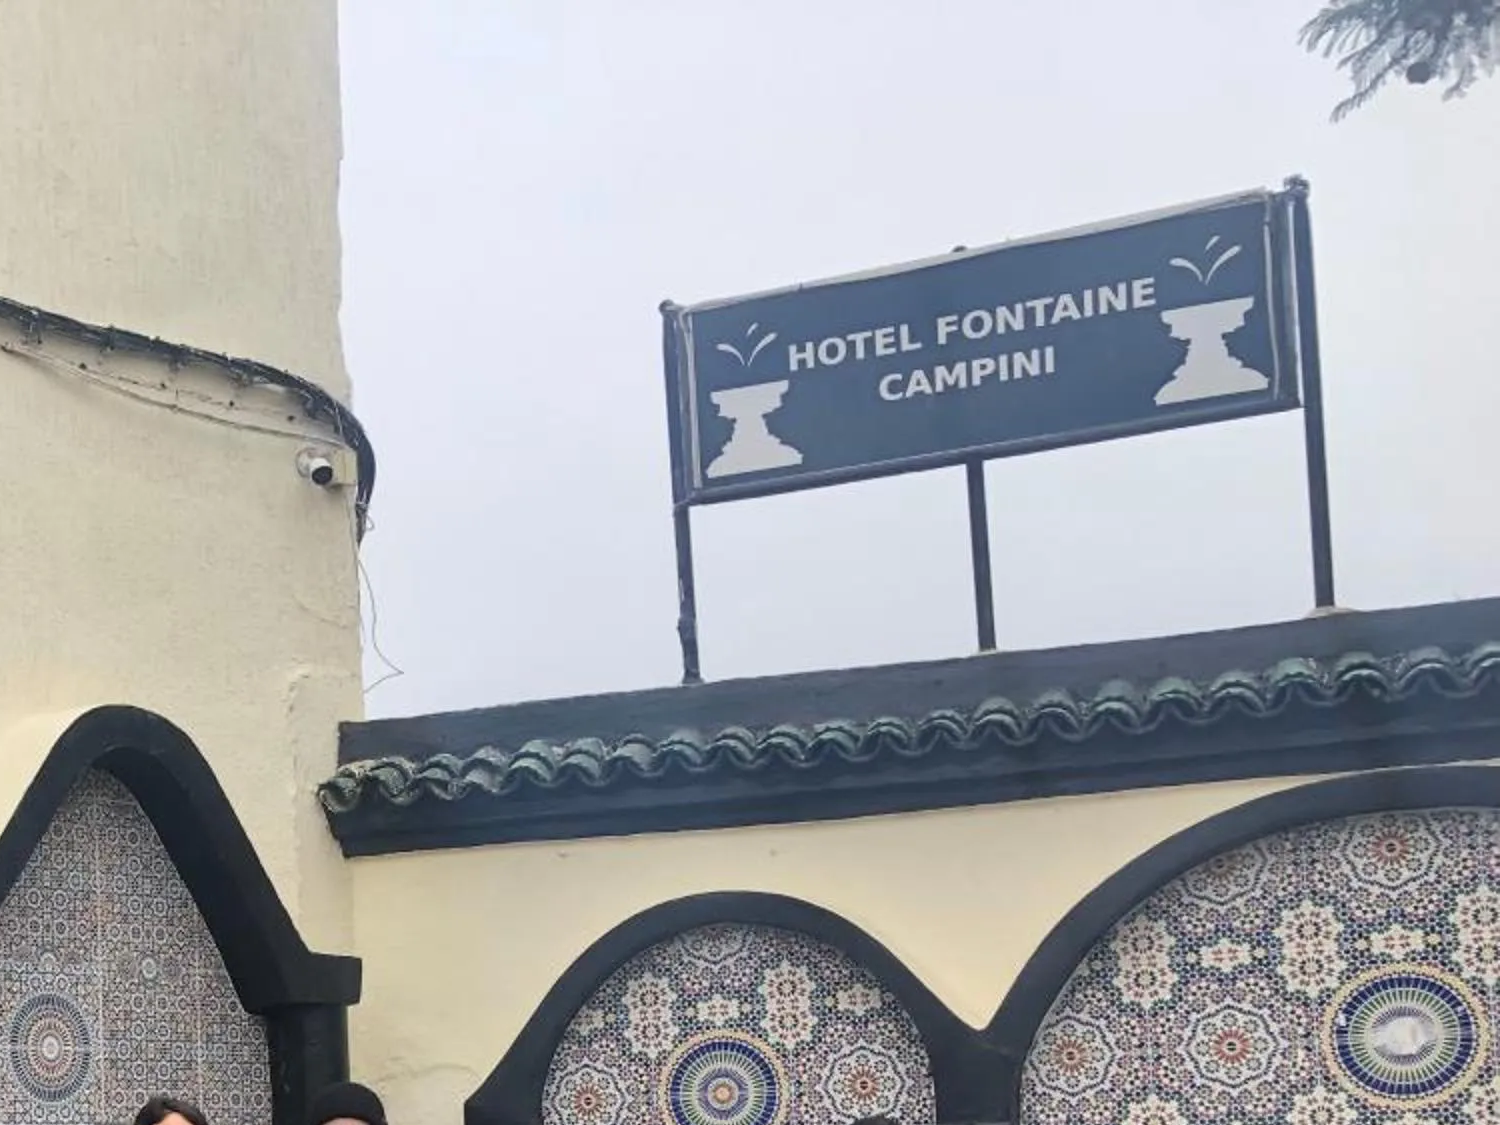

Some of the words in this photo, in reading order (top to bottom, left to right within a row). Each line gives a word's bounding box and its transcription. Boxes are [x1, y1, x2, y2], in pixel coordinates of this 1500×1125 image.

[788, 324, 923, 372] HOTEL
[936, 277, 1157, 346] FONTAINE
[878, 346, 1056, 400] CAMPINI
